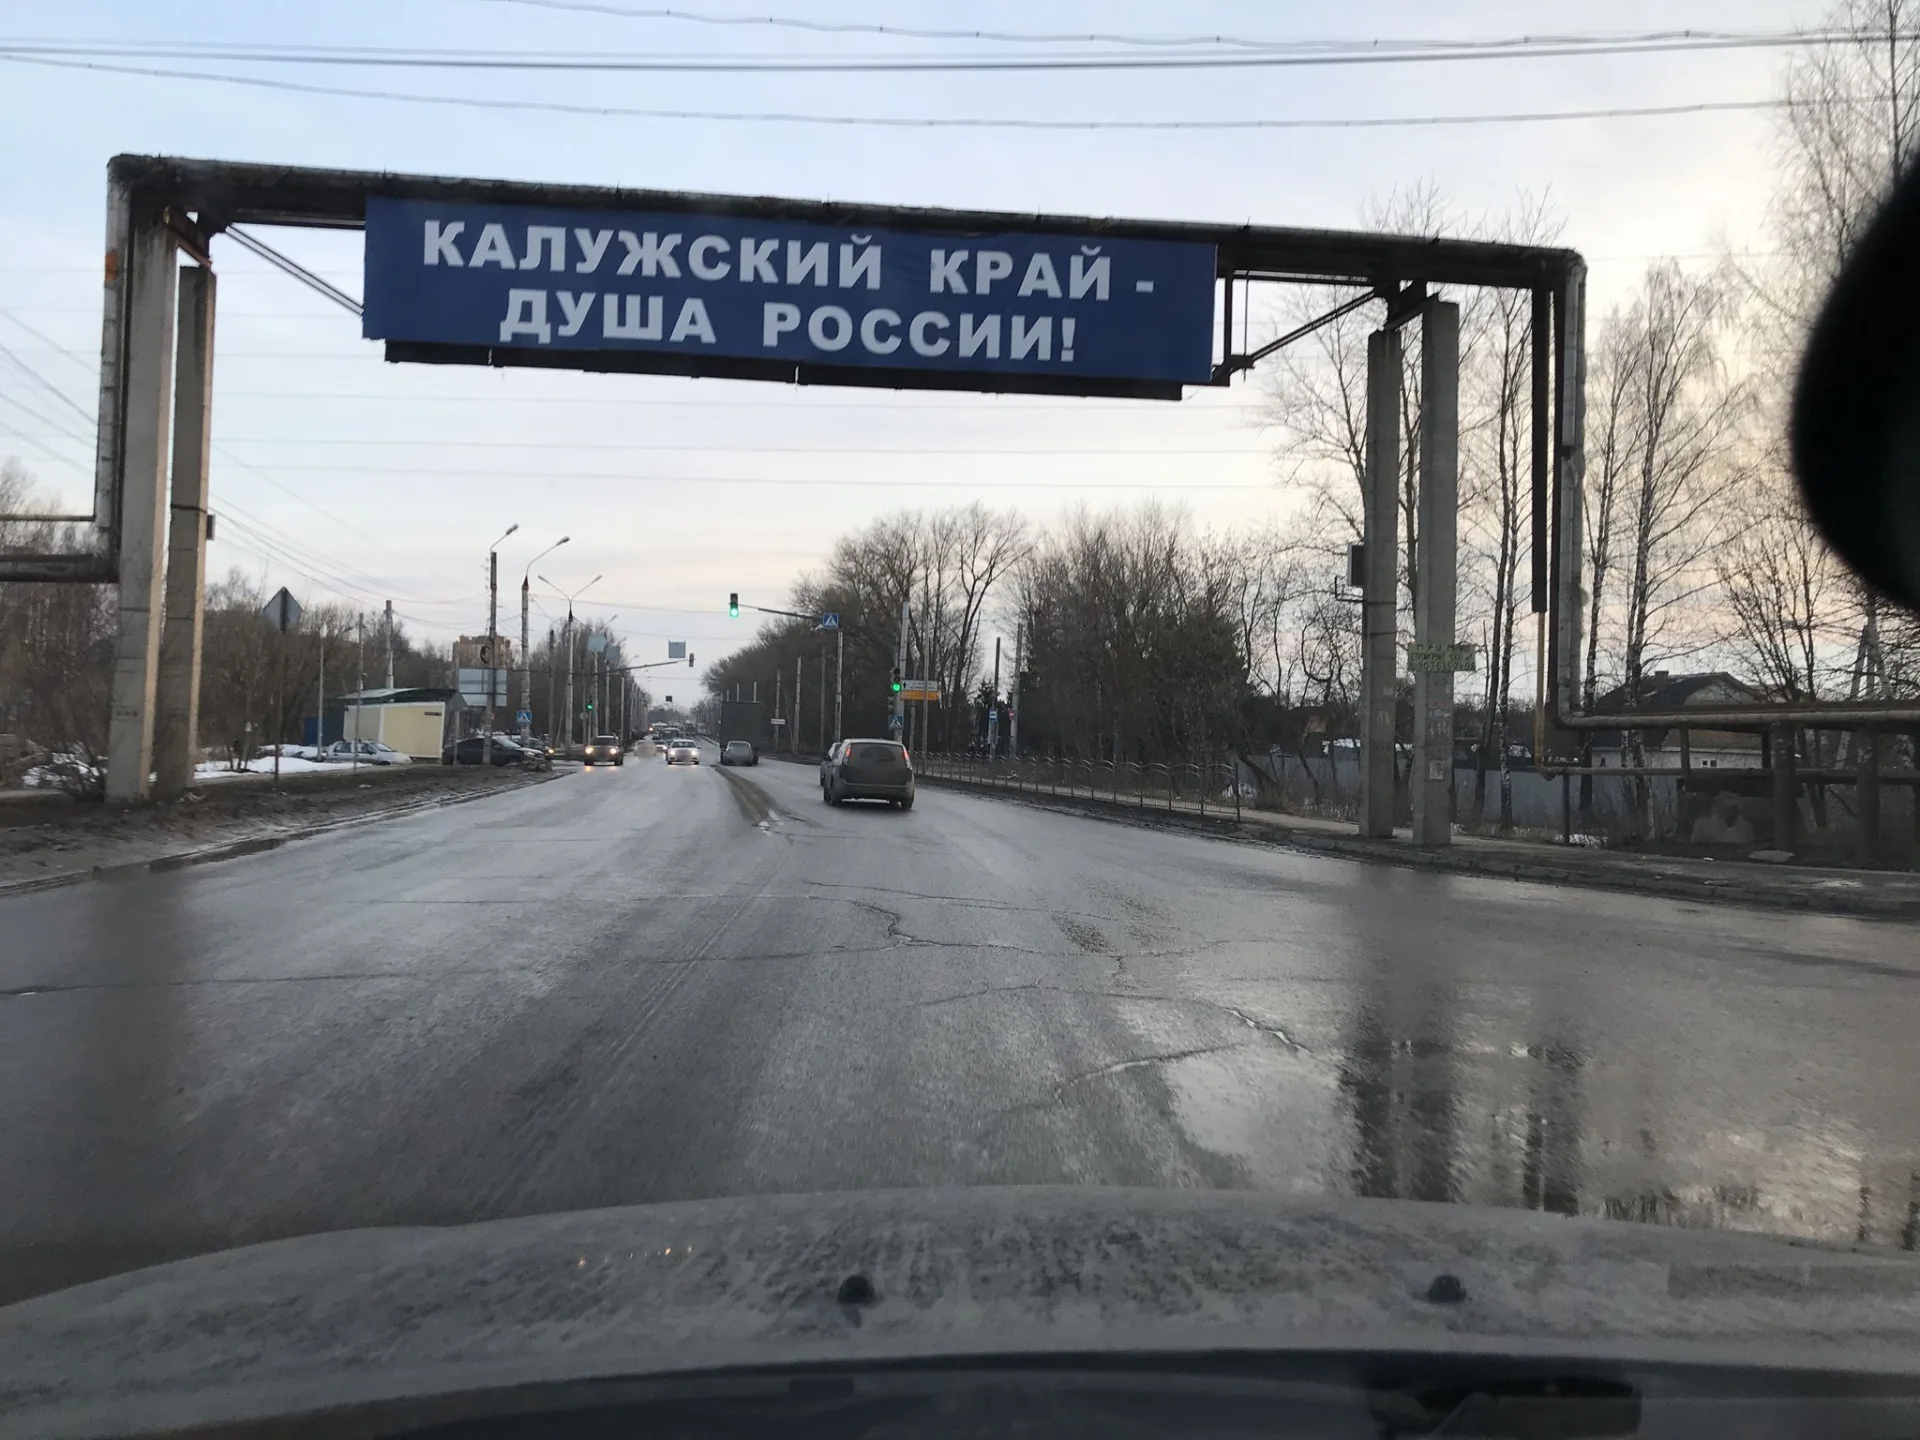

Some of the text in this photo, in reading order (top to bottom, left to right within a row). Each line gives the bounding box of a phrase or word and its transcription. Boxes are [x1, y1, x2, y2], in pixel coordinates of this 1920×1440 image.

[424, 220, 883, 290] КАЛУЖСКИЙ
[931, 246, 1110, 301] КРАЙ
[500, 290, 1075, 361] ДУША РОССИИ!
